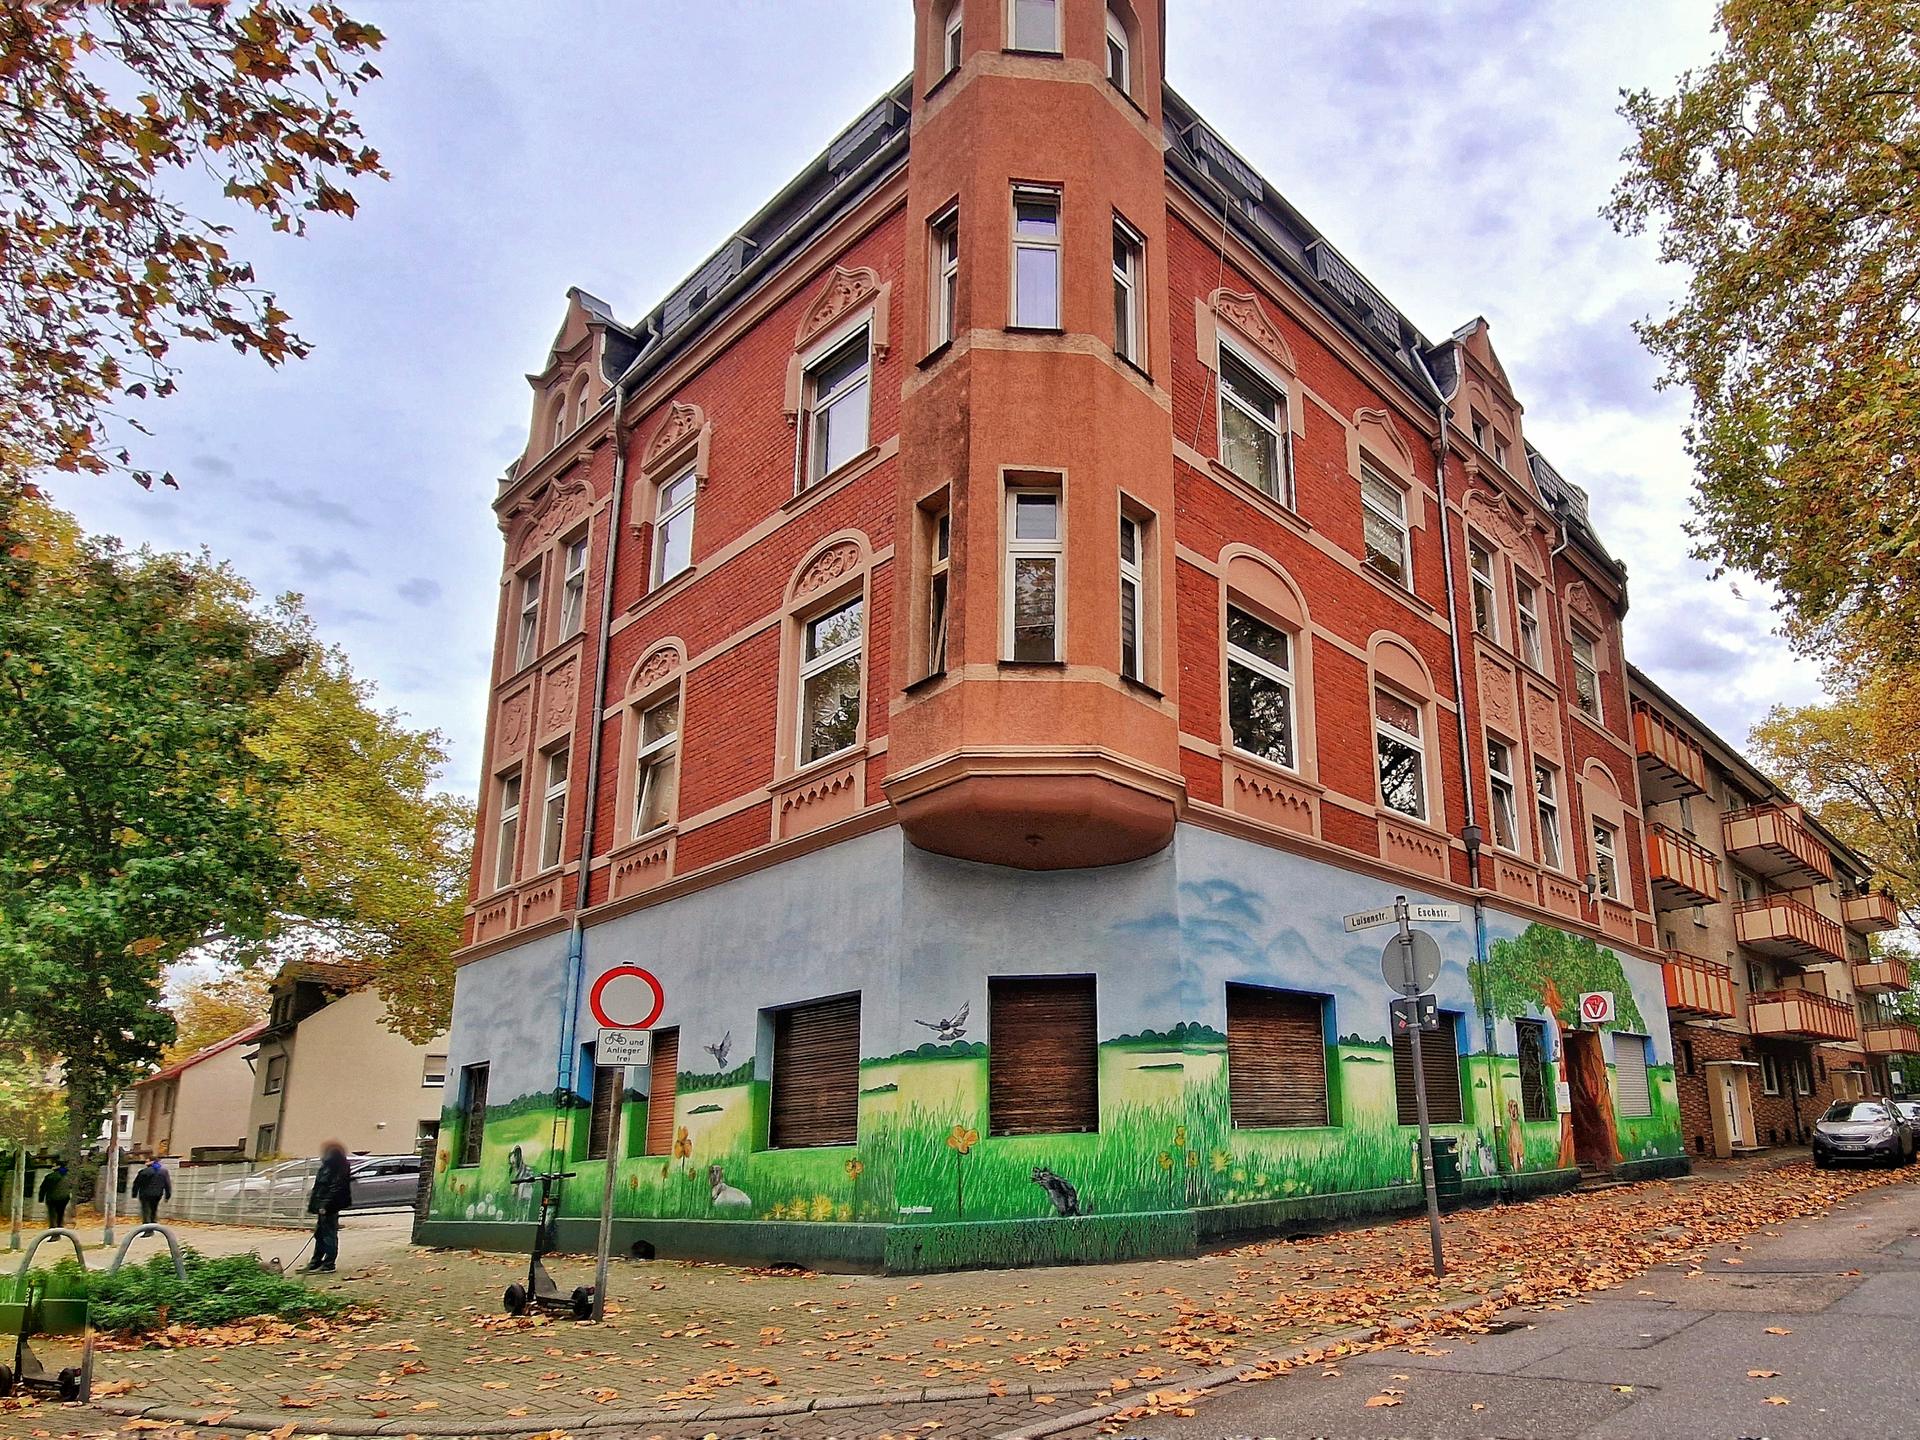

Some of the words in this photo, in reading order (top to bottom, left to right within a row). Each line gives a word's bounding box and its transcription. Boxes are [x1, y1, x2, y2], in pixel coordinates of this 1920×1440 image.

[1417, 907, 1450, 918] Eschstr.
[1351, 912, 1388, 927] Luisenstr.
[606, 1047, 641, 1055] Anlieger
